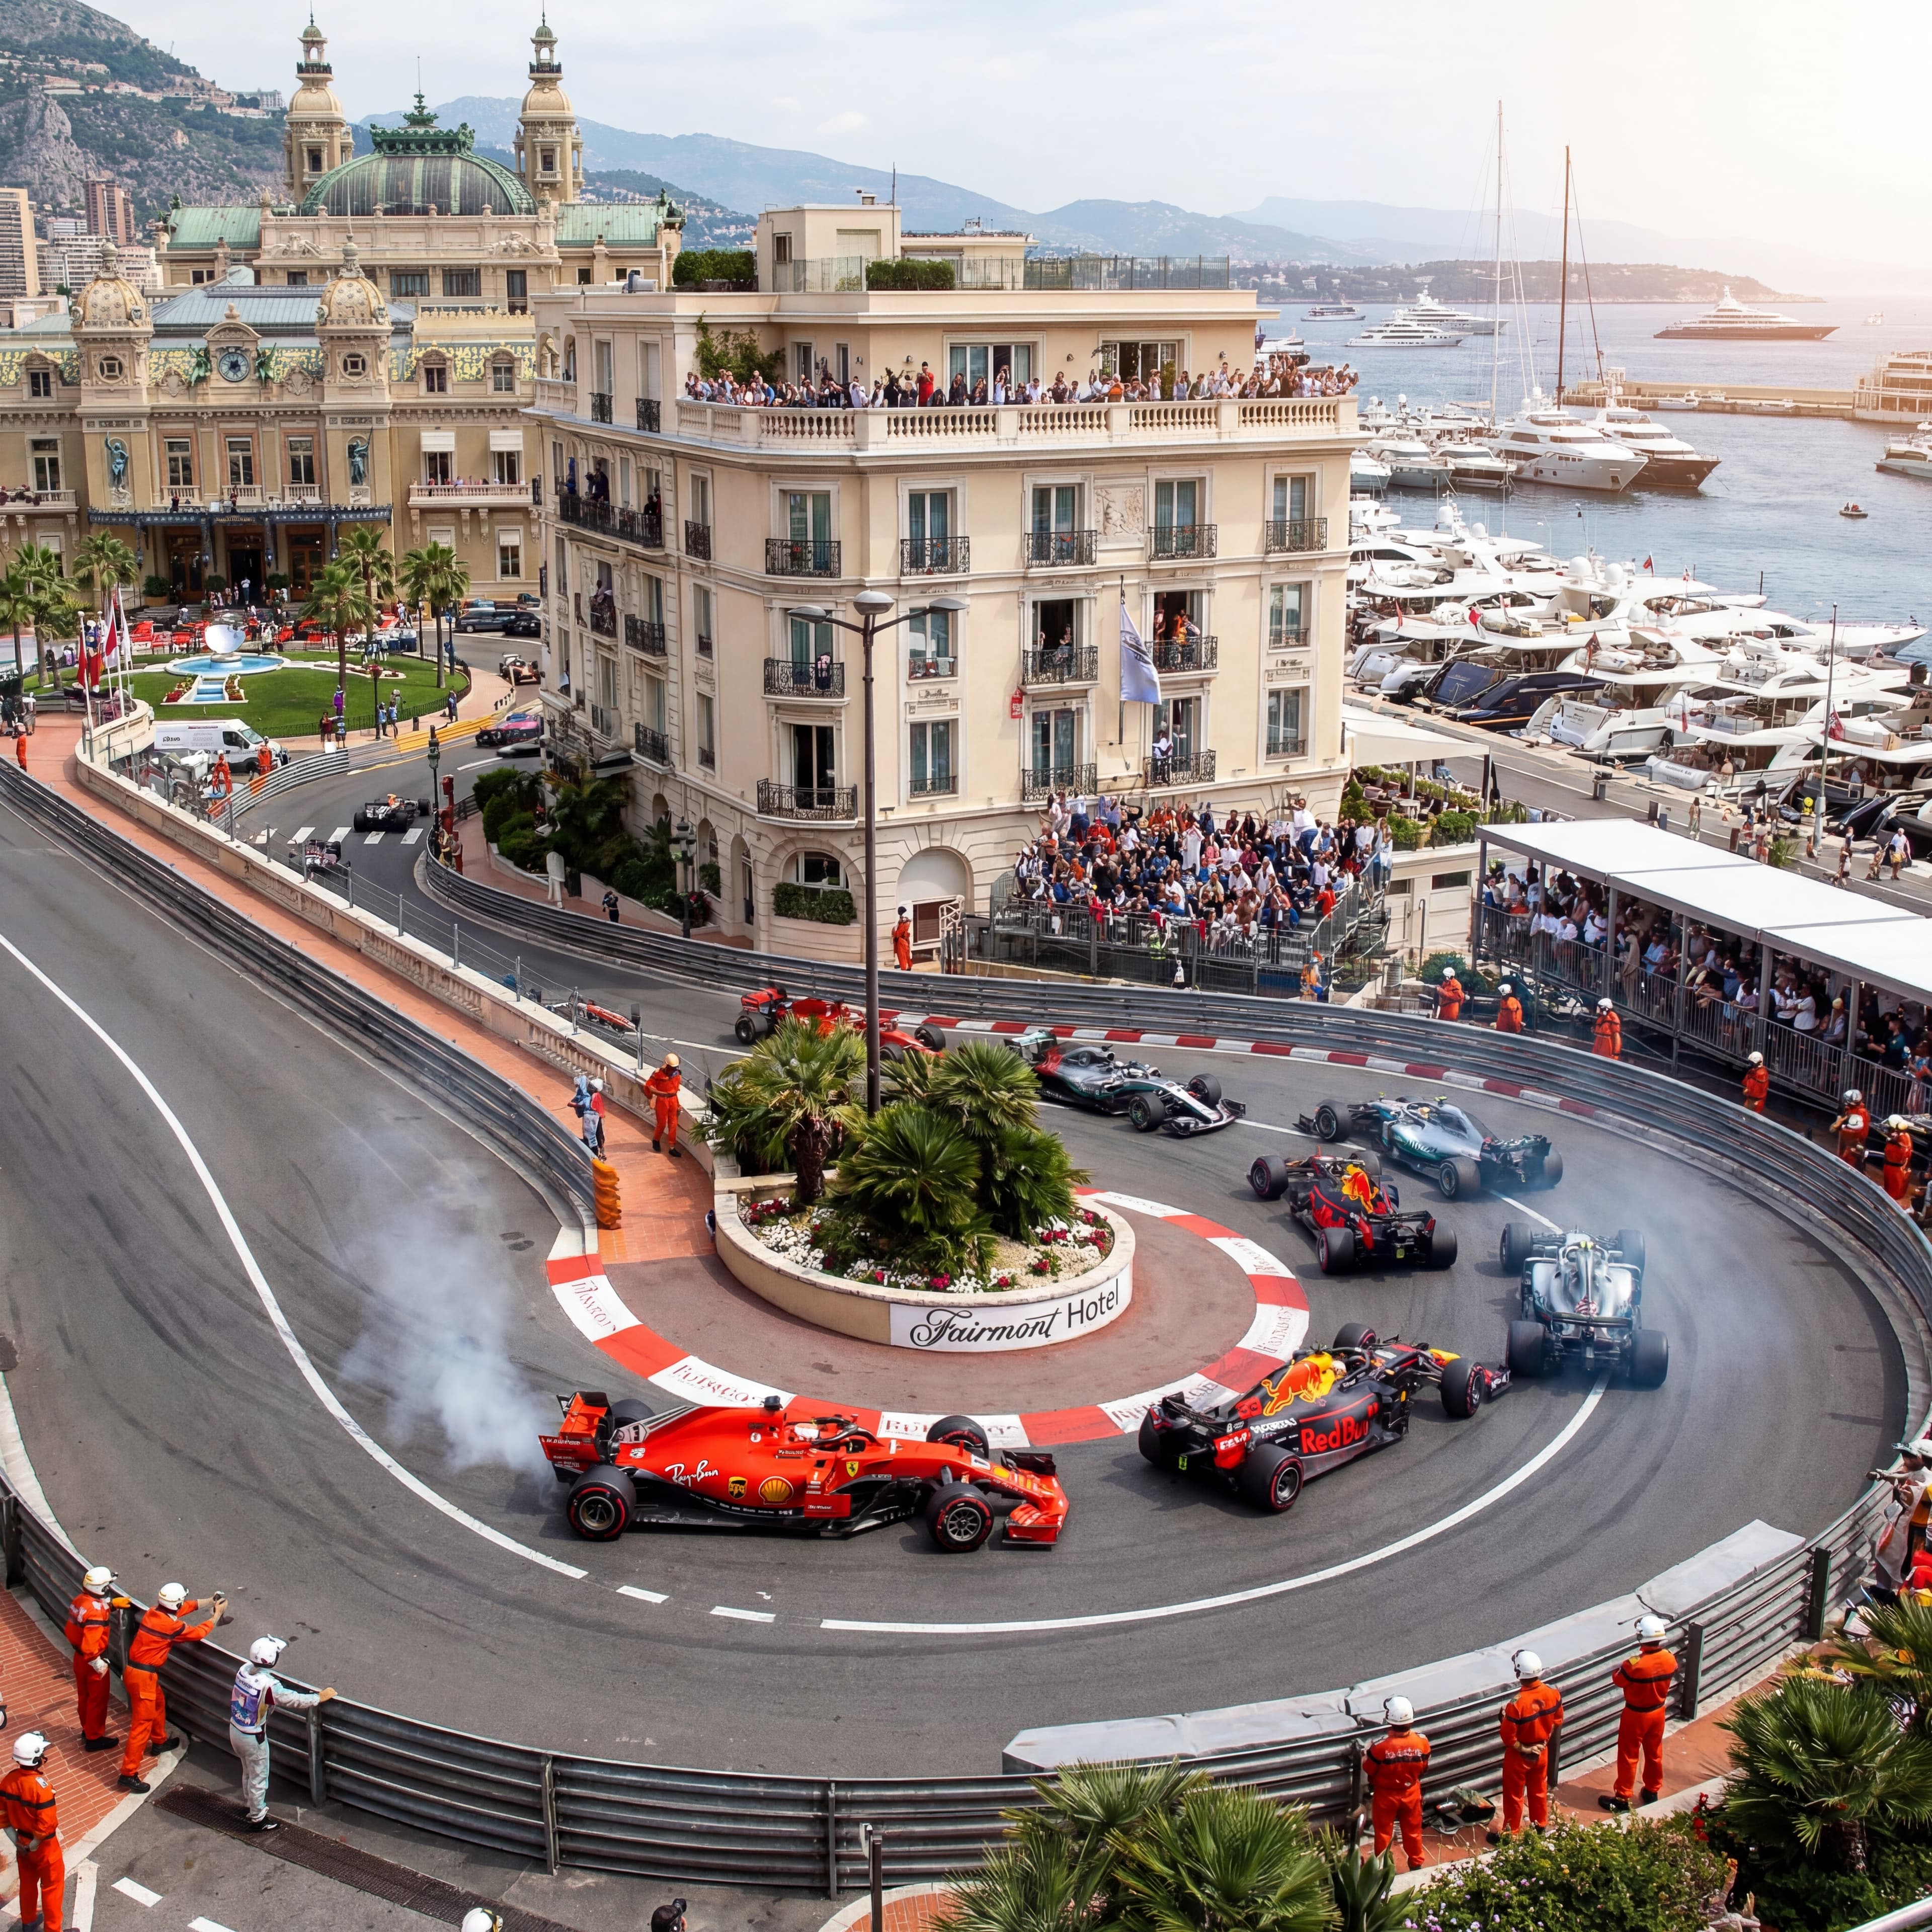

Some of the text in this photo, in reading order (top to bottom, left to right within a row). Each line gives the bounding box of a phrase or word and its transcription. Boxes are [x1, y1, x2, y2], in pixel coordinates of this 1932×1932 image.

[910, 1278, 1118, 1346] Fairmont Hotel
[1301, 1419, 1341, 1454] Red
